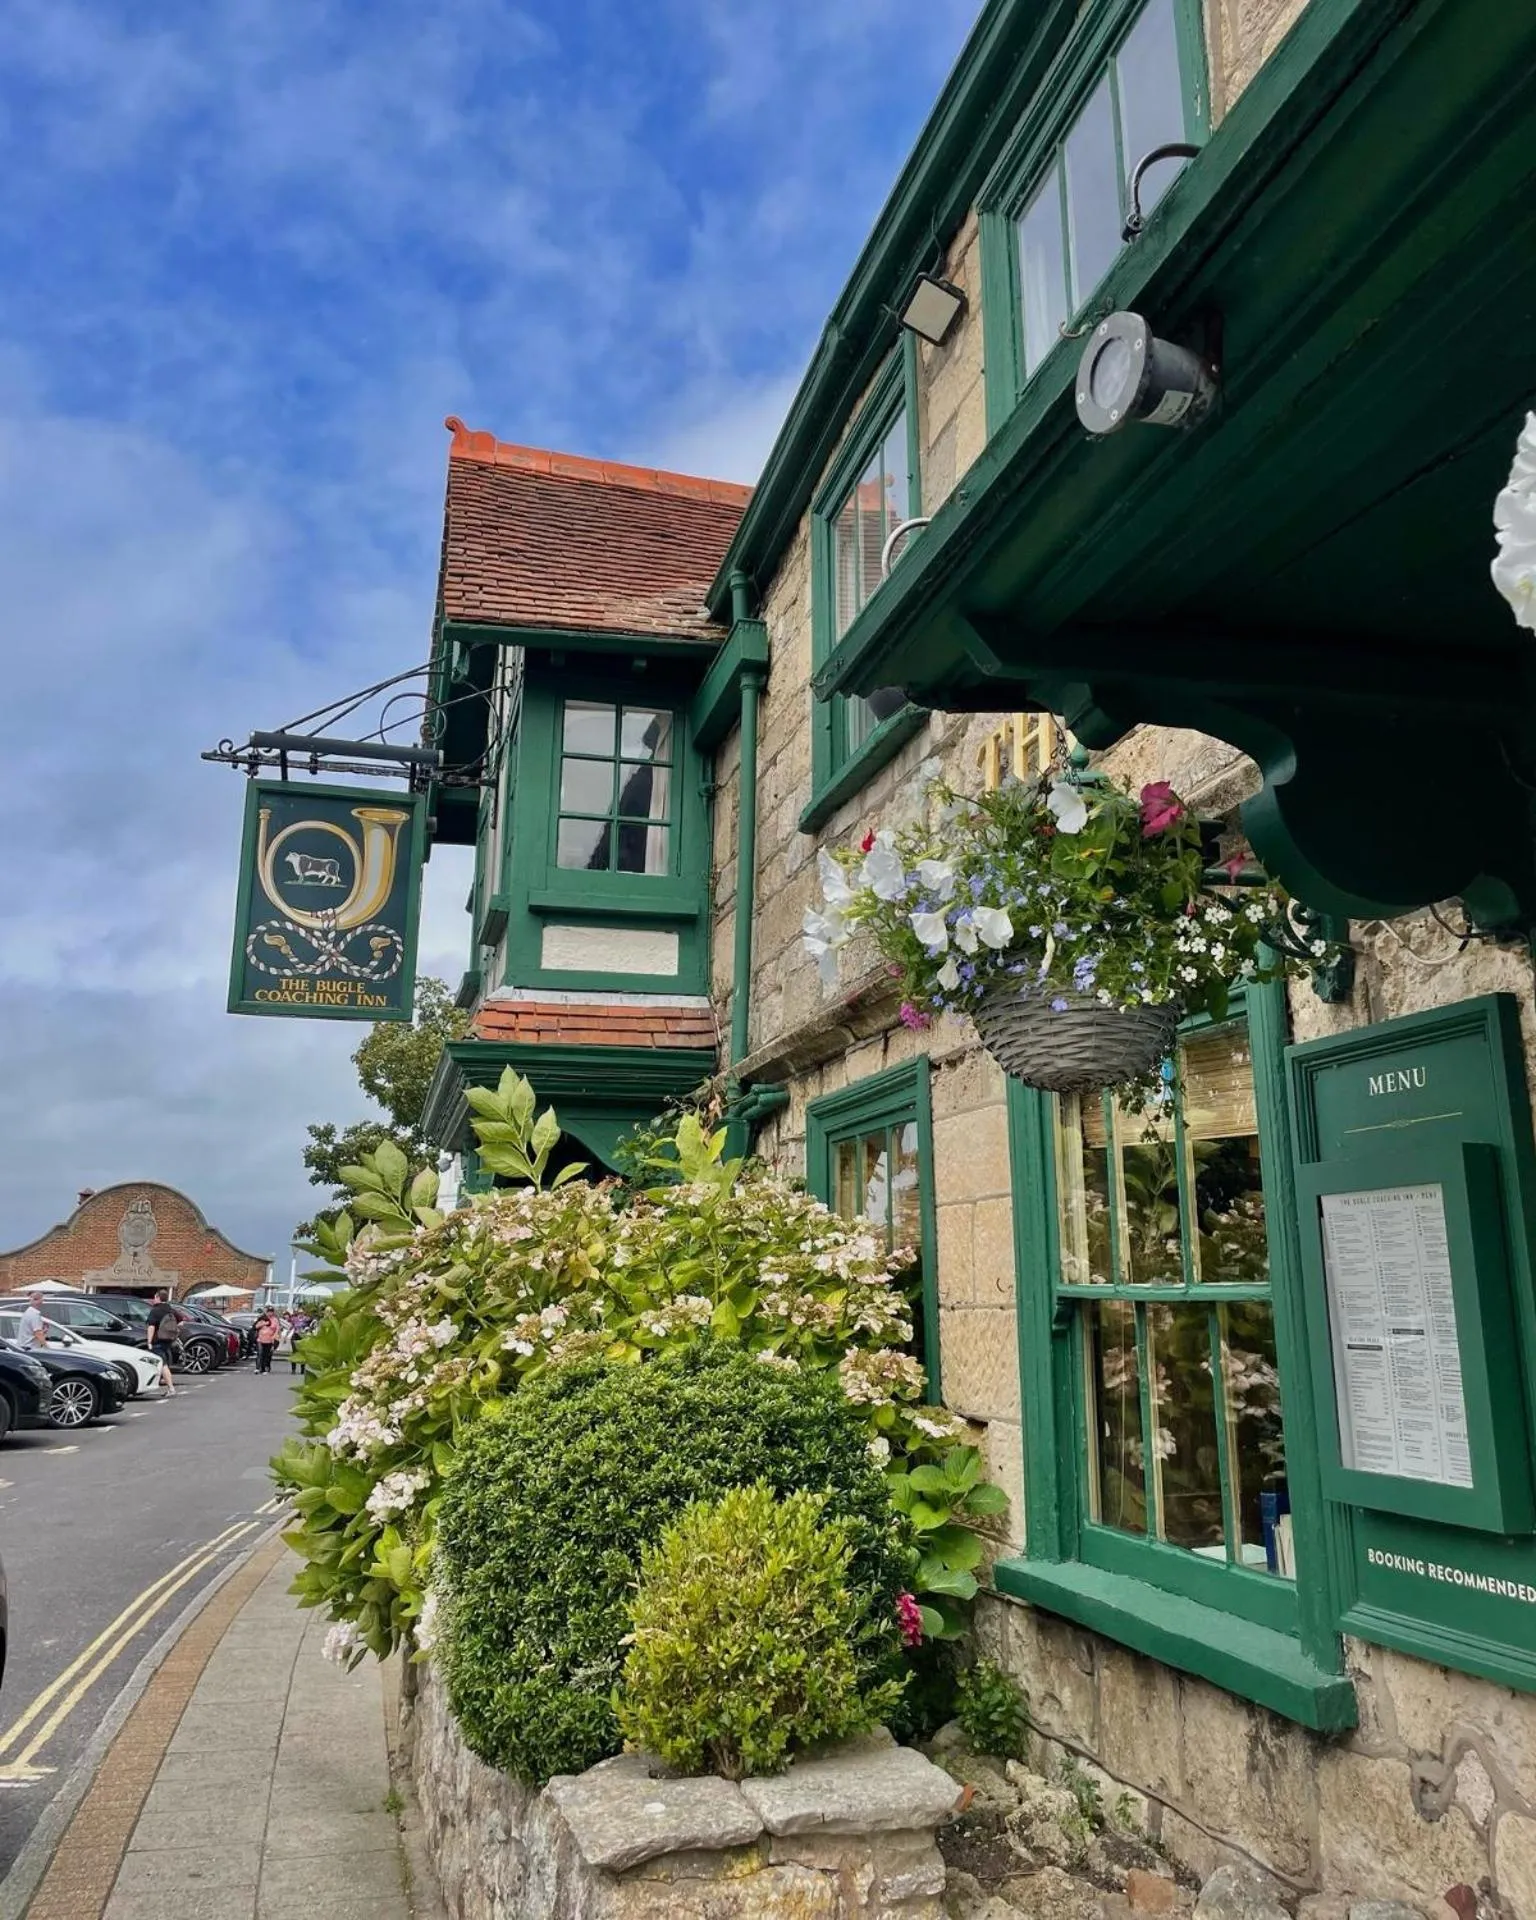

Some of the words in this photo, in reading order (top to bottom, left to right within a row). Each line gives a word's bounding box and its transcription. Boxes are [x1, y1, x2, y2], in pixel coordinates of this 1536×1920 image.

[976, 713, 1076, 792] TH
[254, 989, 349, 1005] COACHING
[356, 994, 388, 1007] INN
[279, 978, 310, 991] THE
[316, 980, 366, 994] BUGLE
[1368, 1066, 1426, 1096] MENU
[1367, 1548, 1426, 1576] BOOKING
[1428, 1562, 1536, 1603] RECOMMENDED
